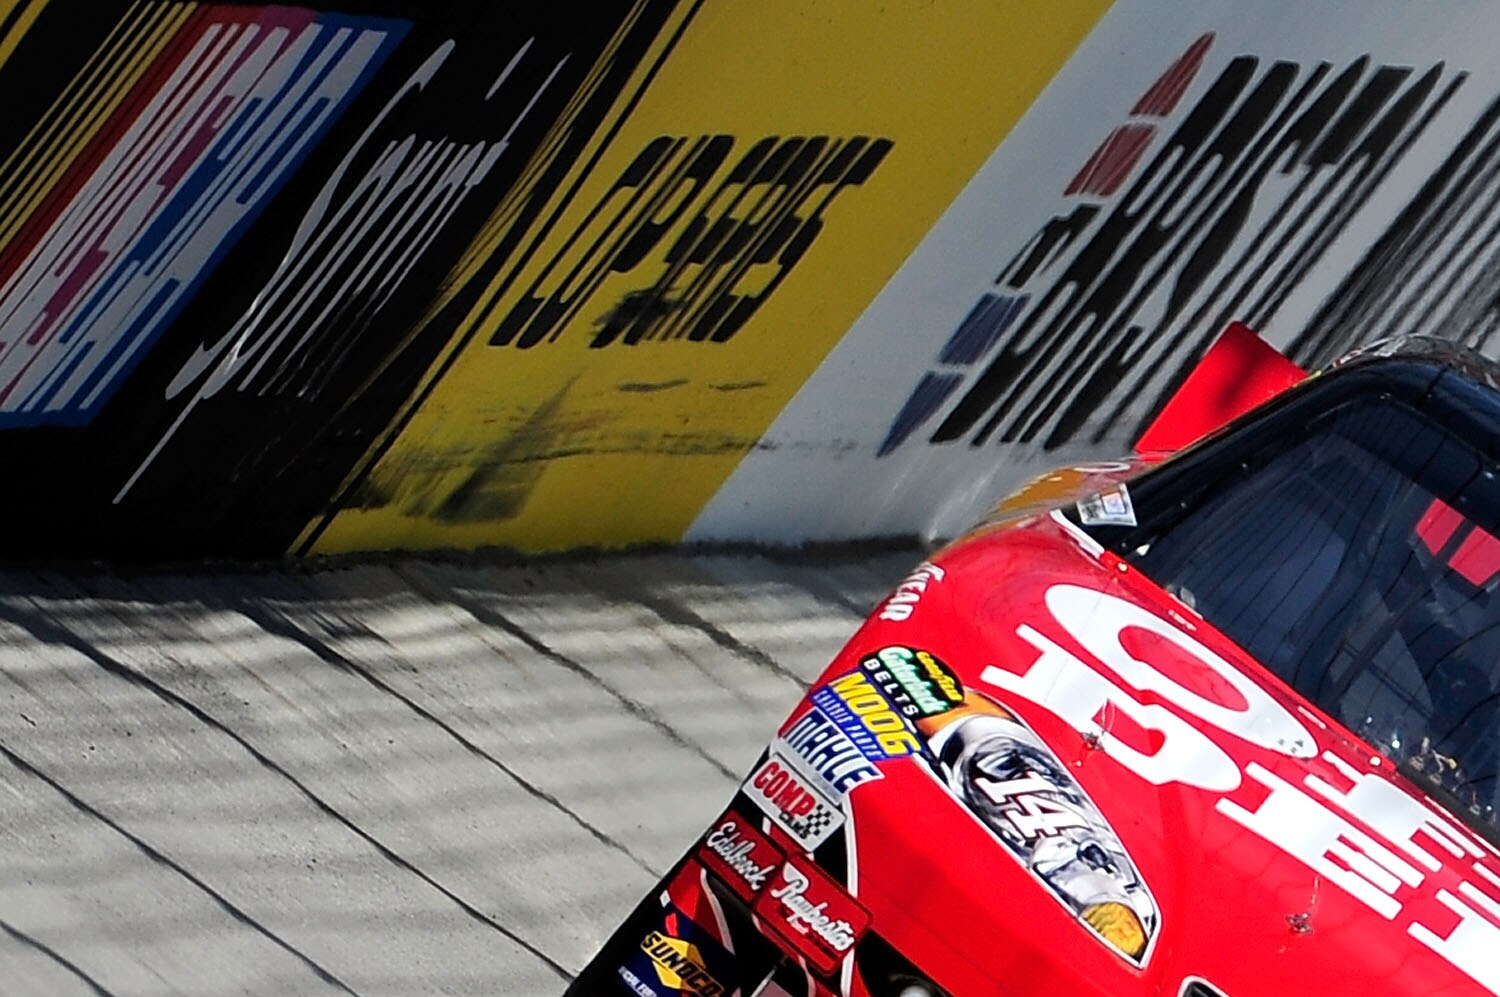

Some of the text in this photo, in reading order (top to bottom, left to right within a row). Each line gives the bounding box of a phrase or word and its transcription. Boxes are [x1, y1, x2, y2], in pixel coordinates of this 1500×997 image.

[0, 21, 388, 412] NASCAR
[487, 134, 896, 350] CUP SERIES
[930, 54, 1470, 452] BRISTOL
[113, 36, 572, 505] Sprint
[812, 689, 886, 761] CHASSIS PARTS
[828, 671, 922, 757] MOOG
[863, 659, 919, 718] BELTS
[753, 761, 817, 818] COMP
[783, 710, 883, 794] MAHLE
[778, 807, 811, 840] CAMS
[976, 770, 1078, 845] 14
[706, 821, 776, 891] Edelbrock
[771, 861, 855, 951] Raybestos
[642, 933, 722, 997] SUNOCO
